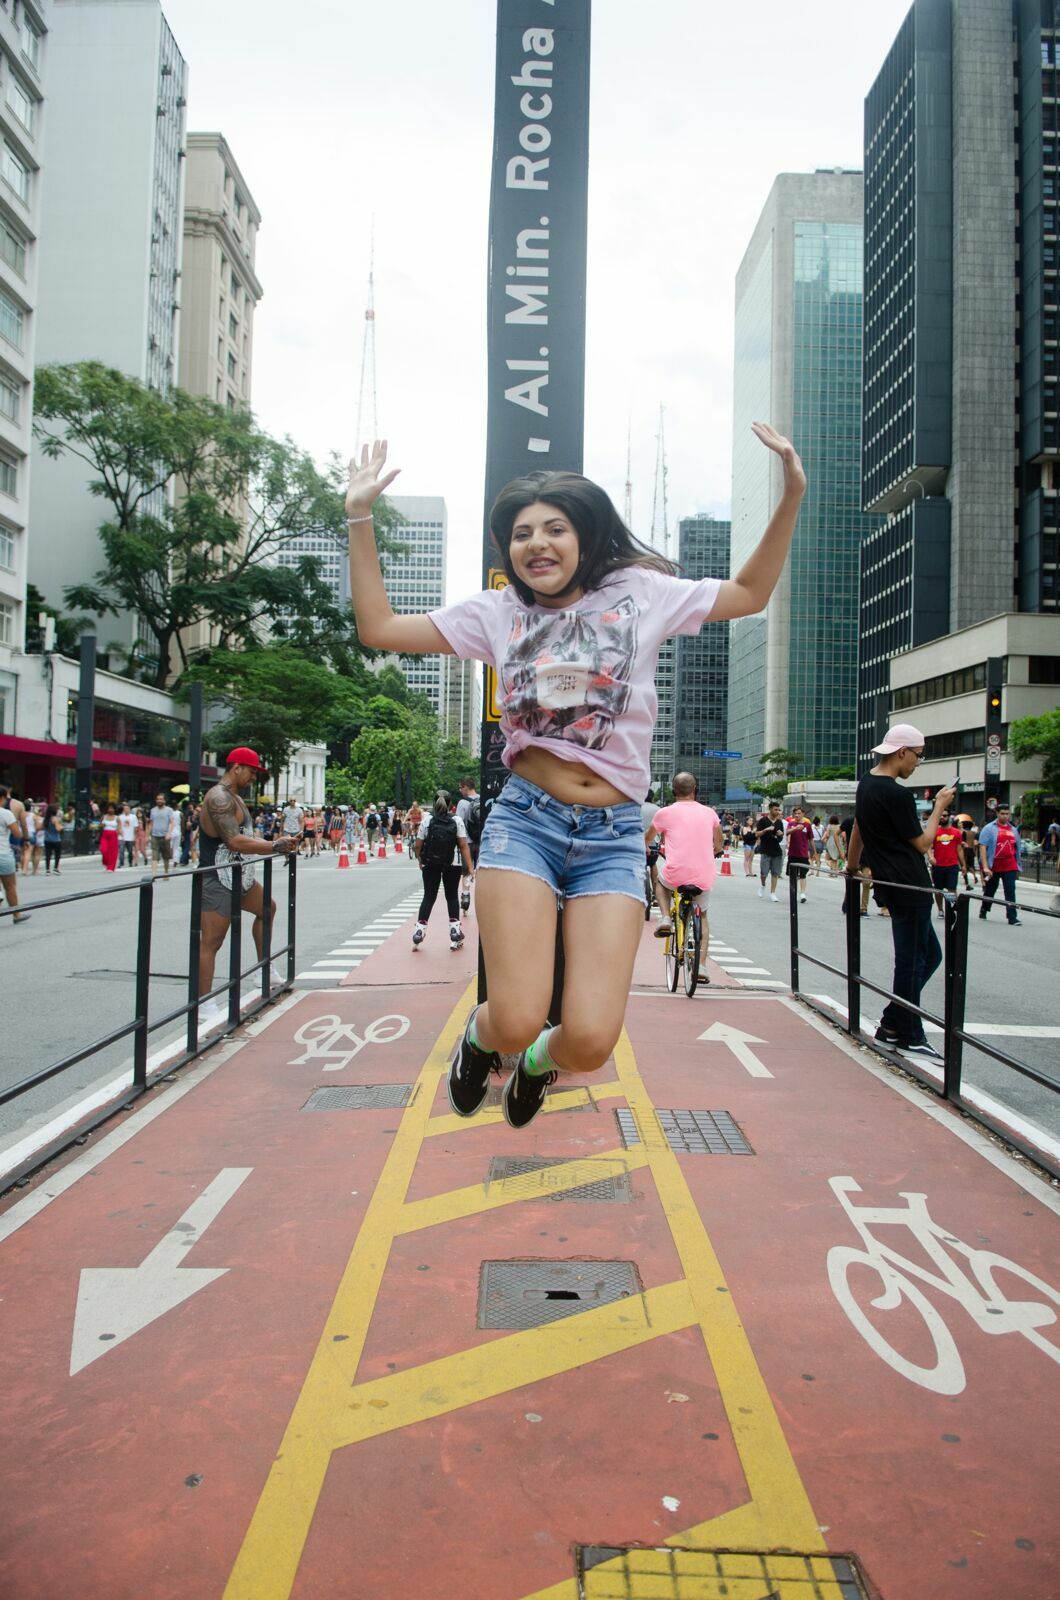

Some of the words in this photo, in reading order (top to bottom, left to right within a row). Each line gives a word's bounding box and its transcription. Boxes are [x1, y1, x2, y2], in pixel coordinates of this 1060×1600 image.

[506, 27, 554, 190] Rocha
[505, 216, 549, 325] Min.
[504, 346, 549, 417] Al.
